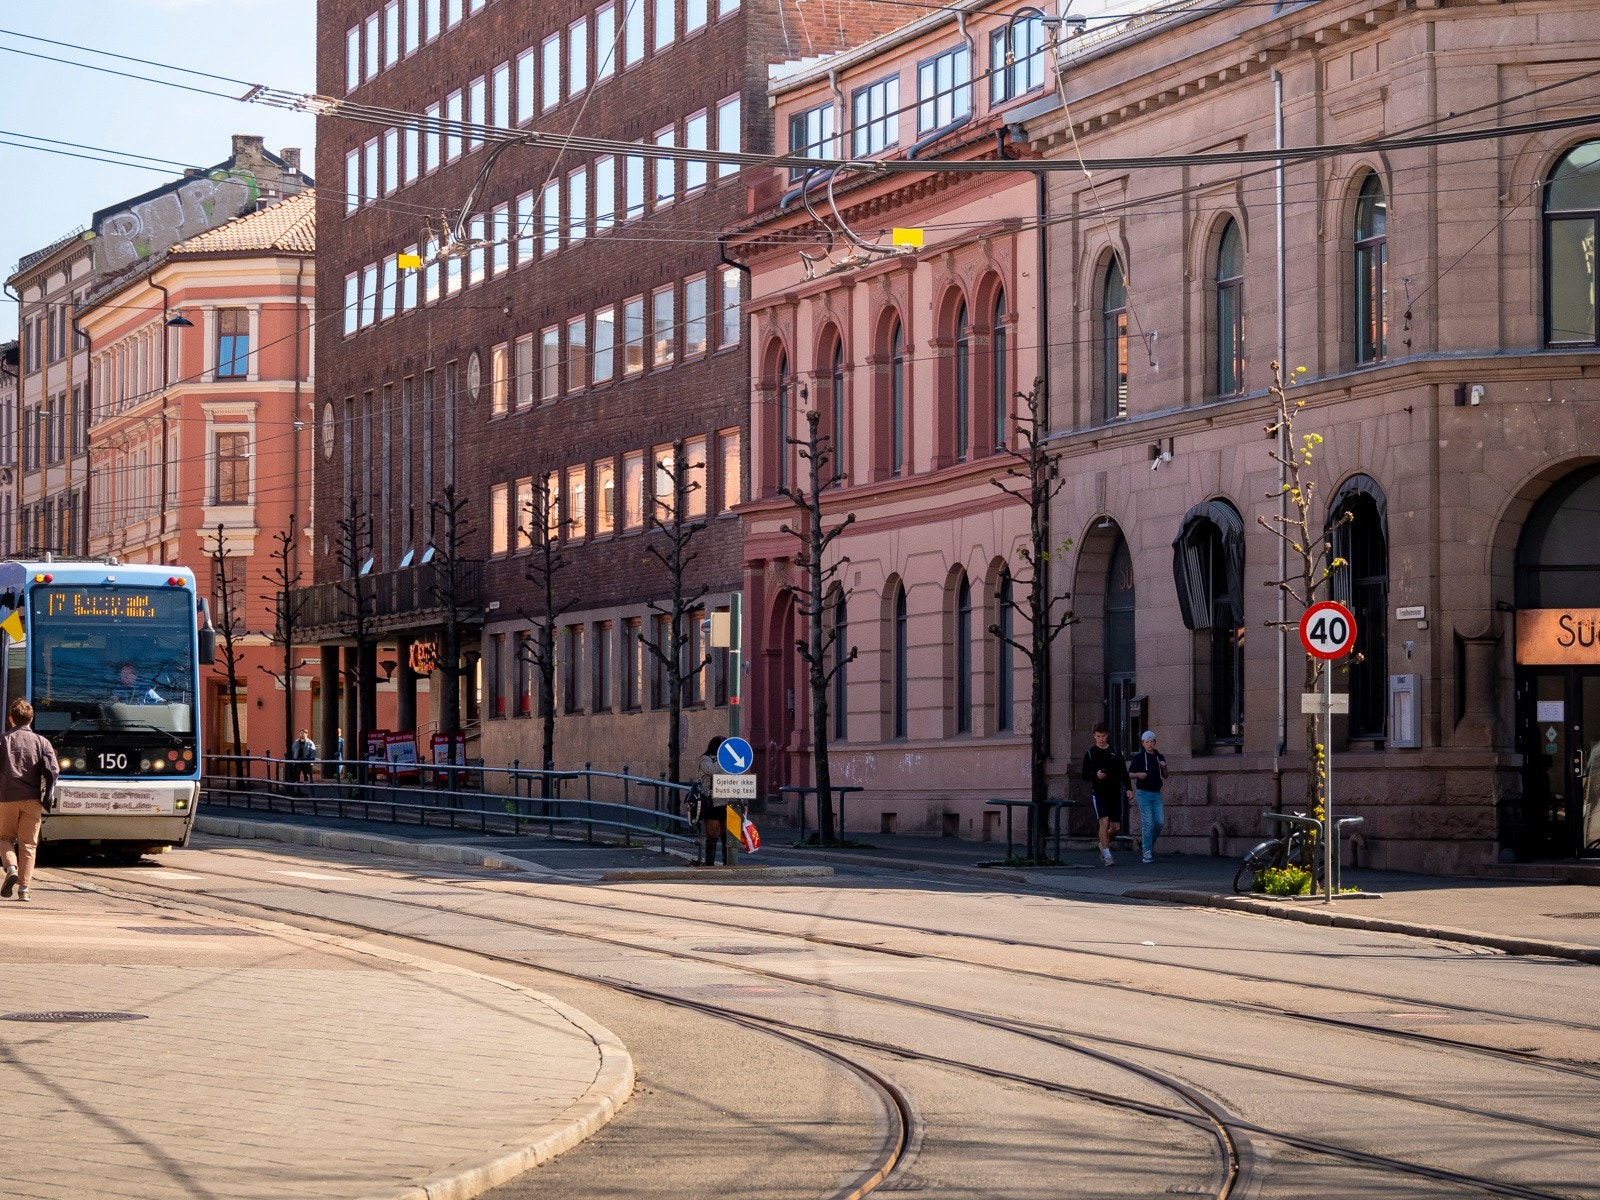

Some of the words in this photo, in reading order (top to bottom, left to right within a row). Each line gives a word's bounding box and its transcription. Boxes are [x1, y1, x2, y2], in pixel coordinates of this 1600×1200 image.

[1309, 616, 1347, 645] 40
[1557, 614, 1600, 648] Sü
[97, 753, 128, 770] 150
[716, 778, 739, 787] Gjelder
